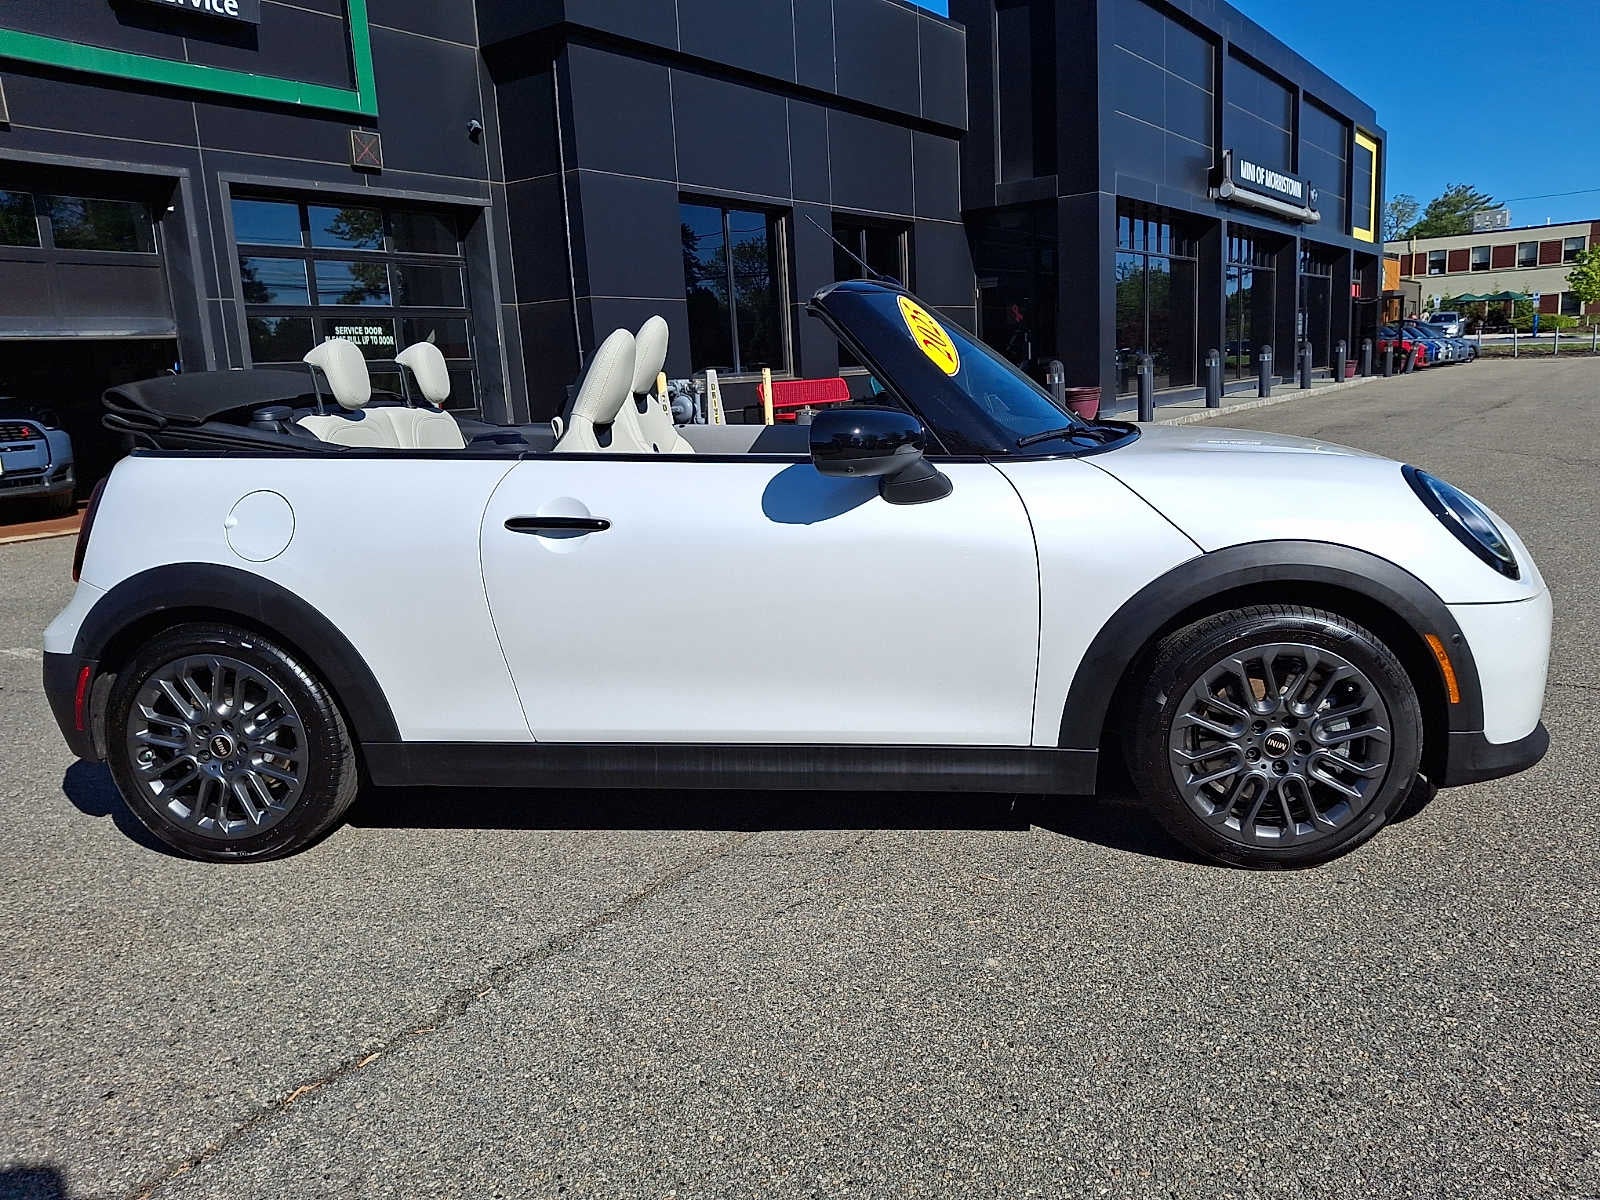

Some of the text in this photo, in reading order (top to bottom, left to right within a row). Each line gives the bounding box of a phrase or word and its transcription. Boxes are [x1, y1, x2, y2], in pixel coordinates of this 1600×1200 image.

[1240, 159, 1302, 199] MINI OF MORRISTOWN
[335, 326, 383, 335] SERVICE DOOR
[362, 335, 370, 345] UP
[370, 335, 378, 345] TO
[379, 335, 395, 345] DOOR
[214, 737, 228, 755] MINI
[1266, 738, 1287, 751] MINI
